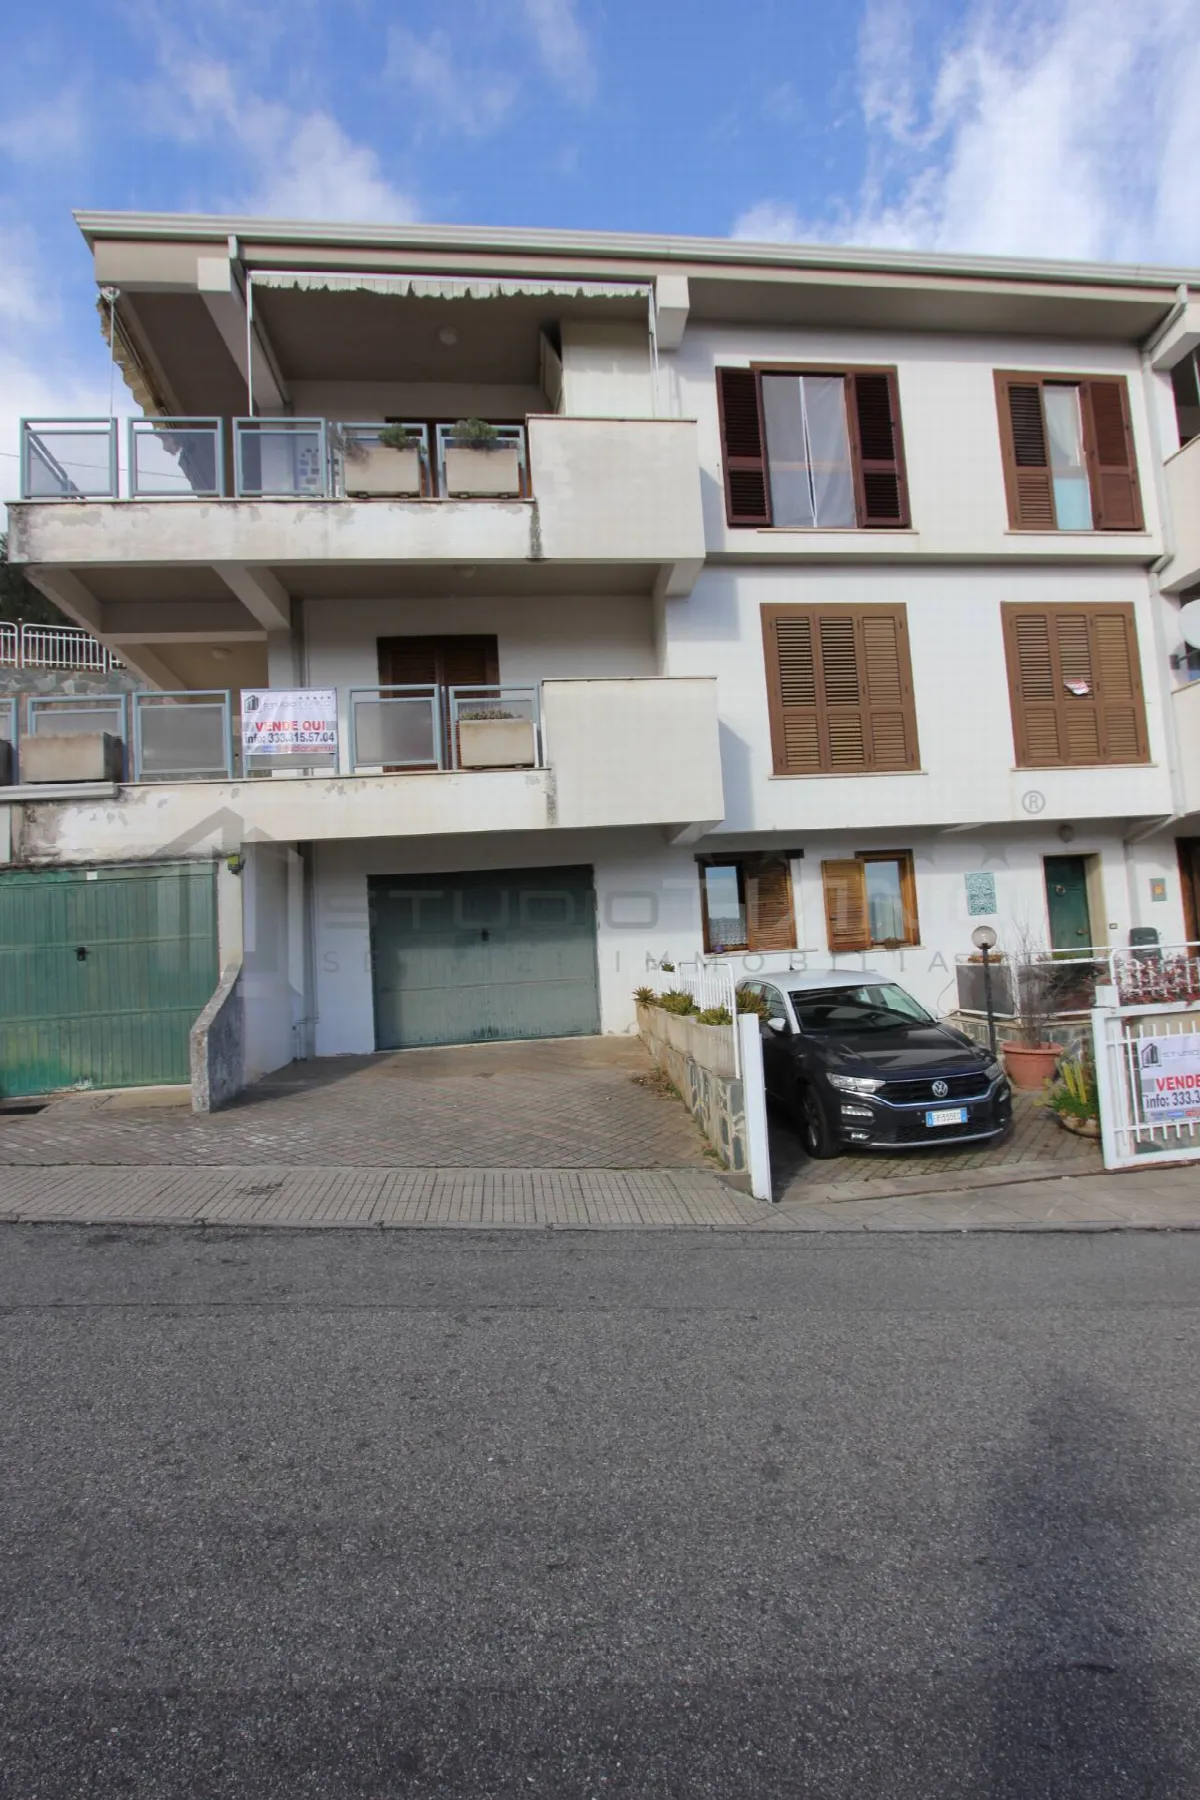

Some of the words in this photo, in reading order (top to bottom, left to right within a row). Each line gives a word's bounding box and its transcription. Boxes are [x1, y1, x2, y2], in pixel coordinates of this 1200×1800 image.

[256, 721, 298, 732] VENDE
[303, 721, 326, 731] QUI
[1156, 1075, 1200, 1092] VENDE
[1146, 1093, 1169, 1108] info:
